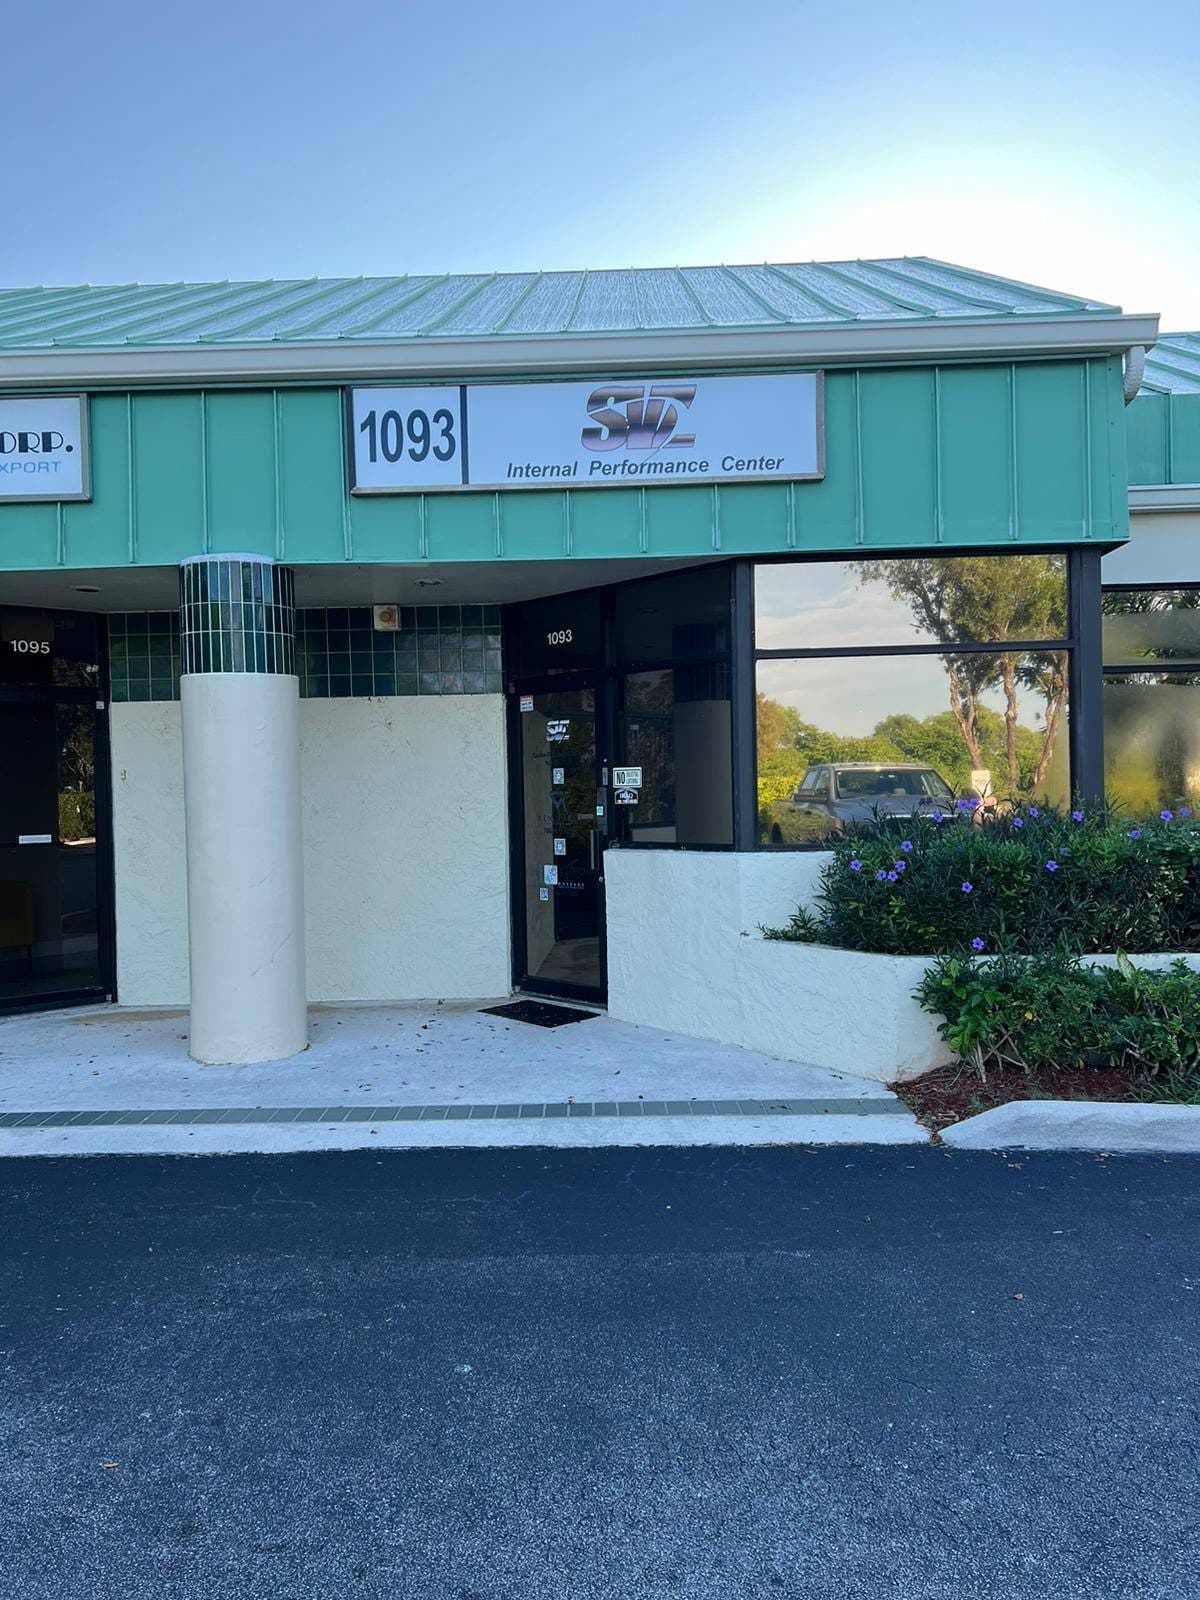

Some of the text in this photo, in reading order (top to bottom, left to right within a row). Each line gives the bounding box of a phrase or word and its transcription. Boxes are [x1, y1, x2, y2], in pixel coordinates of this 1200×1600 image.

[360, 408, 456, 463] 1093
[507, 456, 785, 478] Internal Performance Center
[547, 629, 573, 645] 1093
[10, 640, 50, 654] 1095
[616, 771, 626, 784] NO
